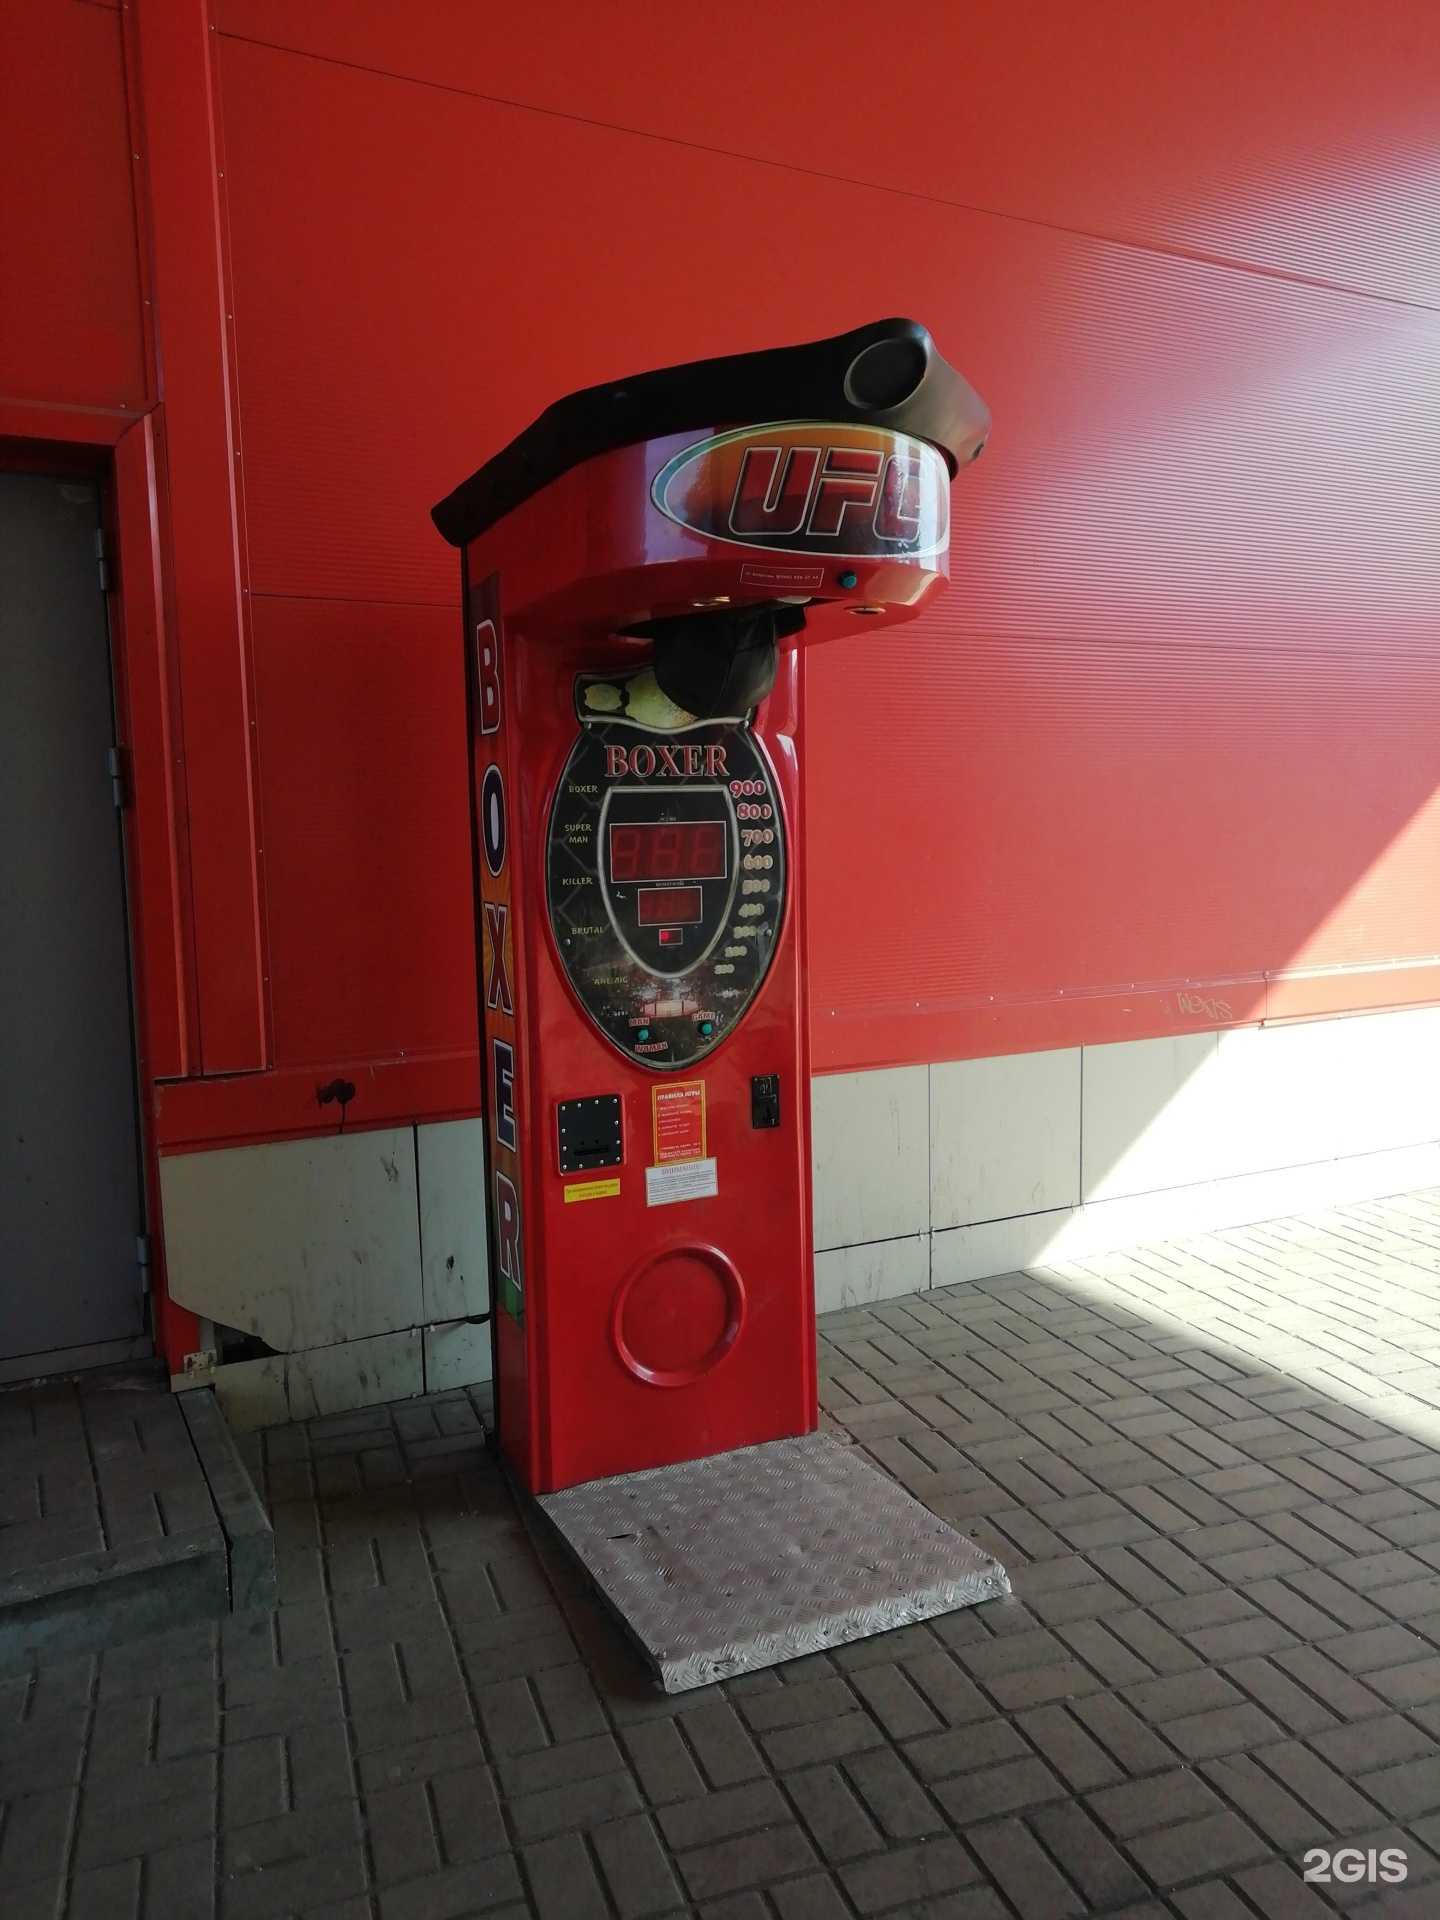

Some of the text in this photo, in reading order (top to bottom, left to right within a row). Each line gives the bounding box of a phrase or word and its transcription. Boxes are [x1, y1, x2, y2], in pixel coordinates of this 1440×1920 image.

[730, 446, 922, 541] UFC
[604, 744, 730, 778] BOXER
[568, 785, 599, 793] BOXER
[729, 780, 766, 798] 900
[737, 803, 772, 820] 800
[564, 823, 593, 832] SUPER
[569, 836, 588, 844] MAN
[741, 829, 774, 847] 700
[562, 877, 593, 886] KILLER
[571, 926, 605, 935] BRUTAL
